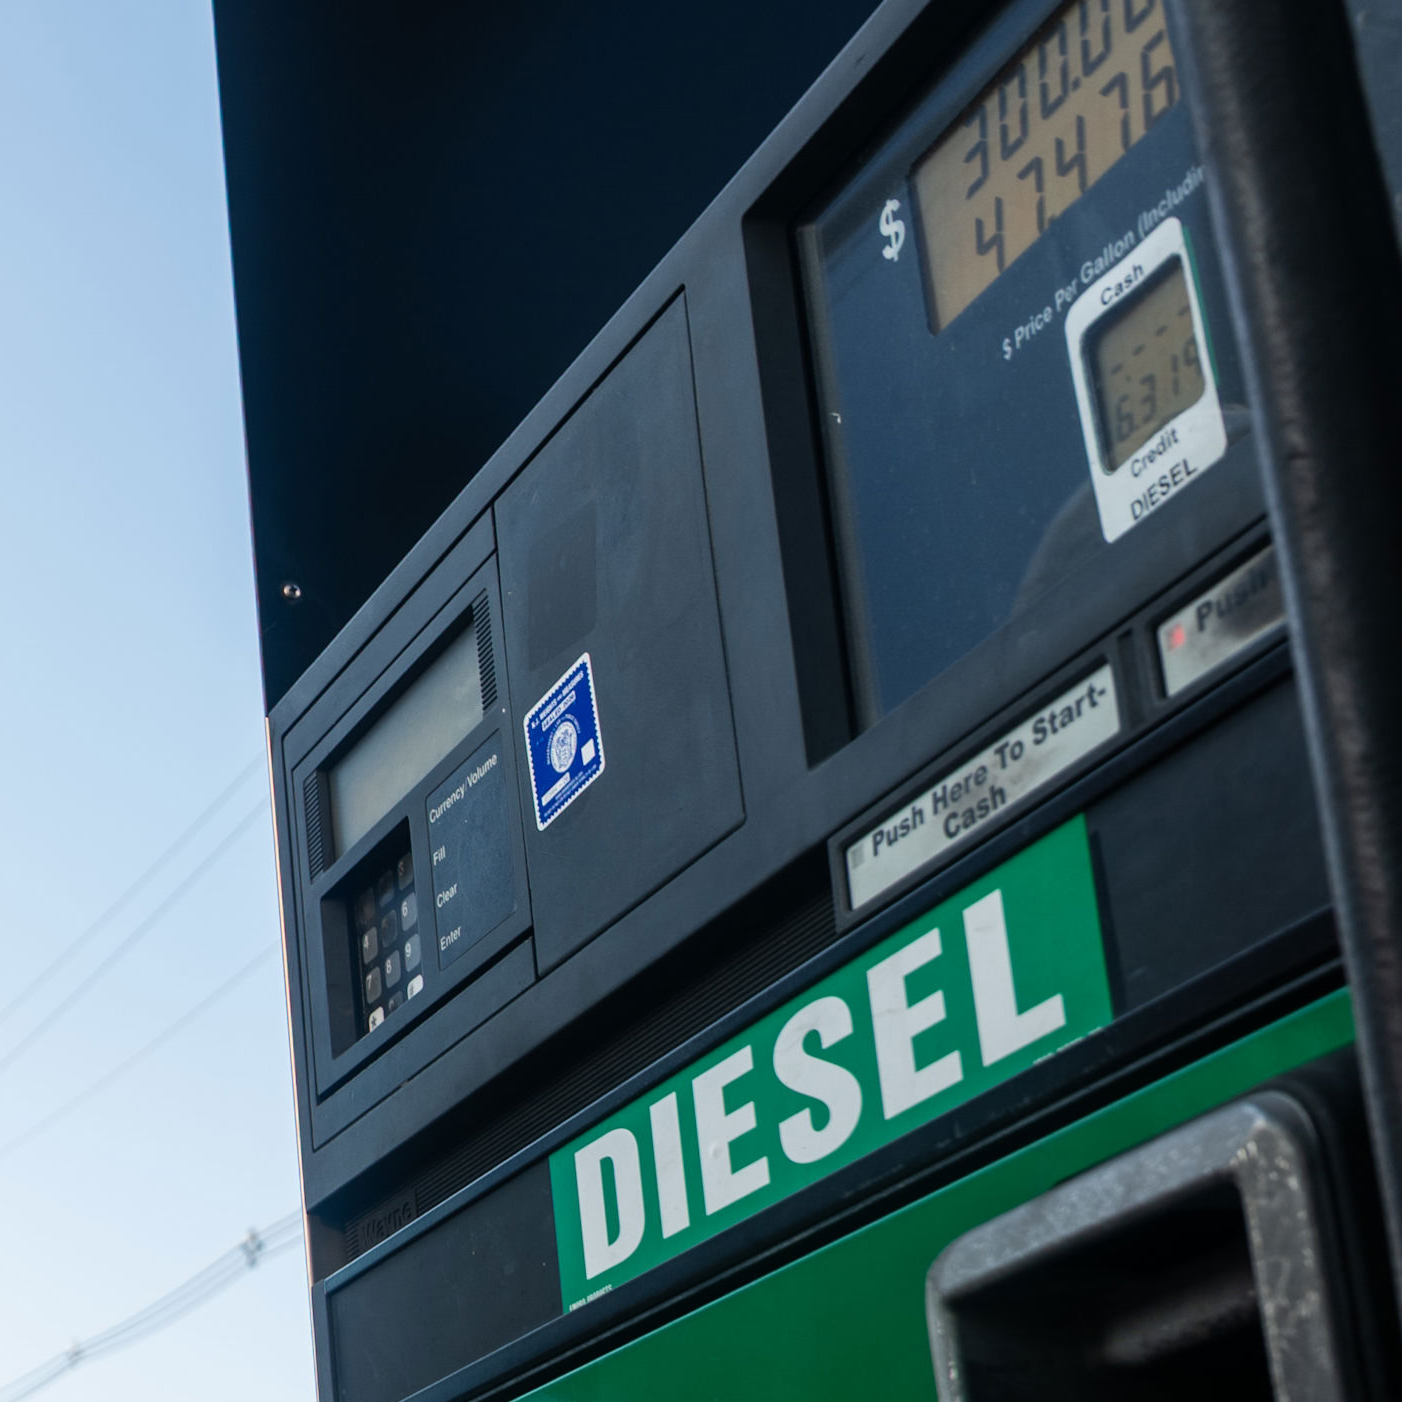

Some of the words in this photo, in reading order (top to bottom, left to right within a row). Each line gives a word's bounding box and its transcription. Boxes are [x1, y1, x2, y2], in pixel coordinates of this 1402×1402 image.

[879, 199, 905, 261] $
[1014, 306, 1053, 349] Price
[1054, 278, 1077, 312] Per
[1081, 230, 1136, 284] Gallon
[1100, 264, 1144, 306] Cash
[1130, 428, 1180, 478] Credit
[1130, 458, 1198, 521] DIESEL
[429, 754, 498, 823] Currency/Volume
[872, 806, 924, 857] Push
[932, 764, 988, 816] Here
[994, 740, 1025, 770] To
[1032, 682, 1106, 746] Start-
[943, 784, 1007, 840] Cash
[433, 845, 446, 866] Fill
[401, 901, 408, 917] 6
[437, 883, 459, 908] Clear
[404, 942, 411, 957] 9
[440, 926, 462, 951] Enter
[574, 888, 1067, 1280] DIESEL
